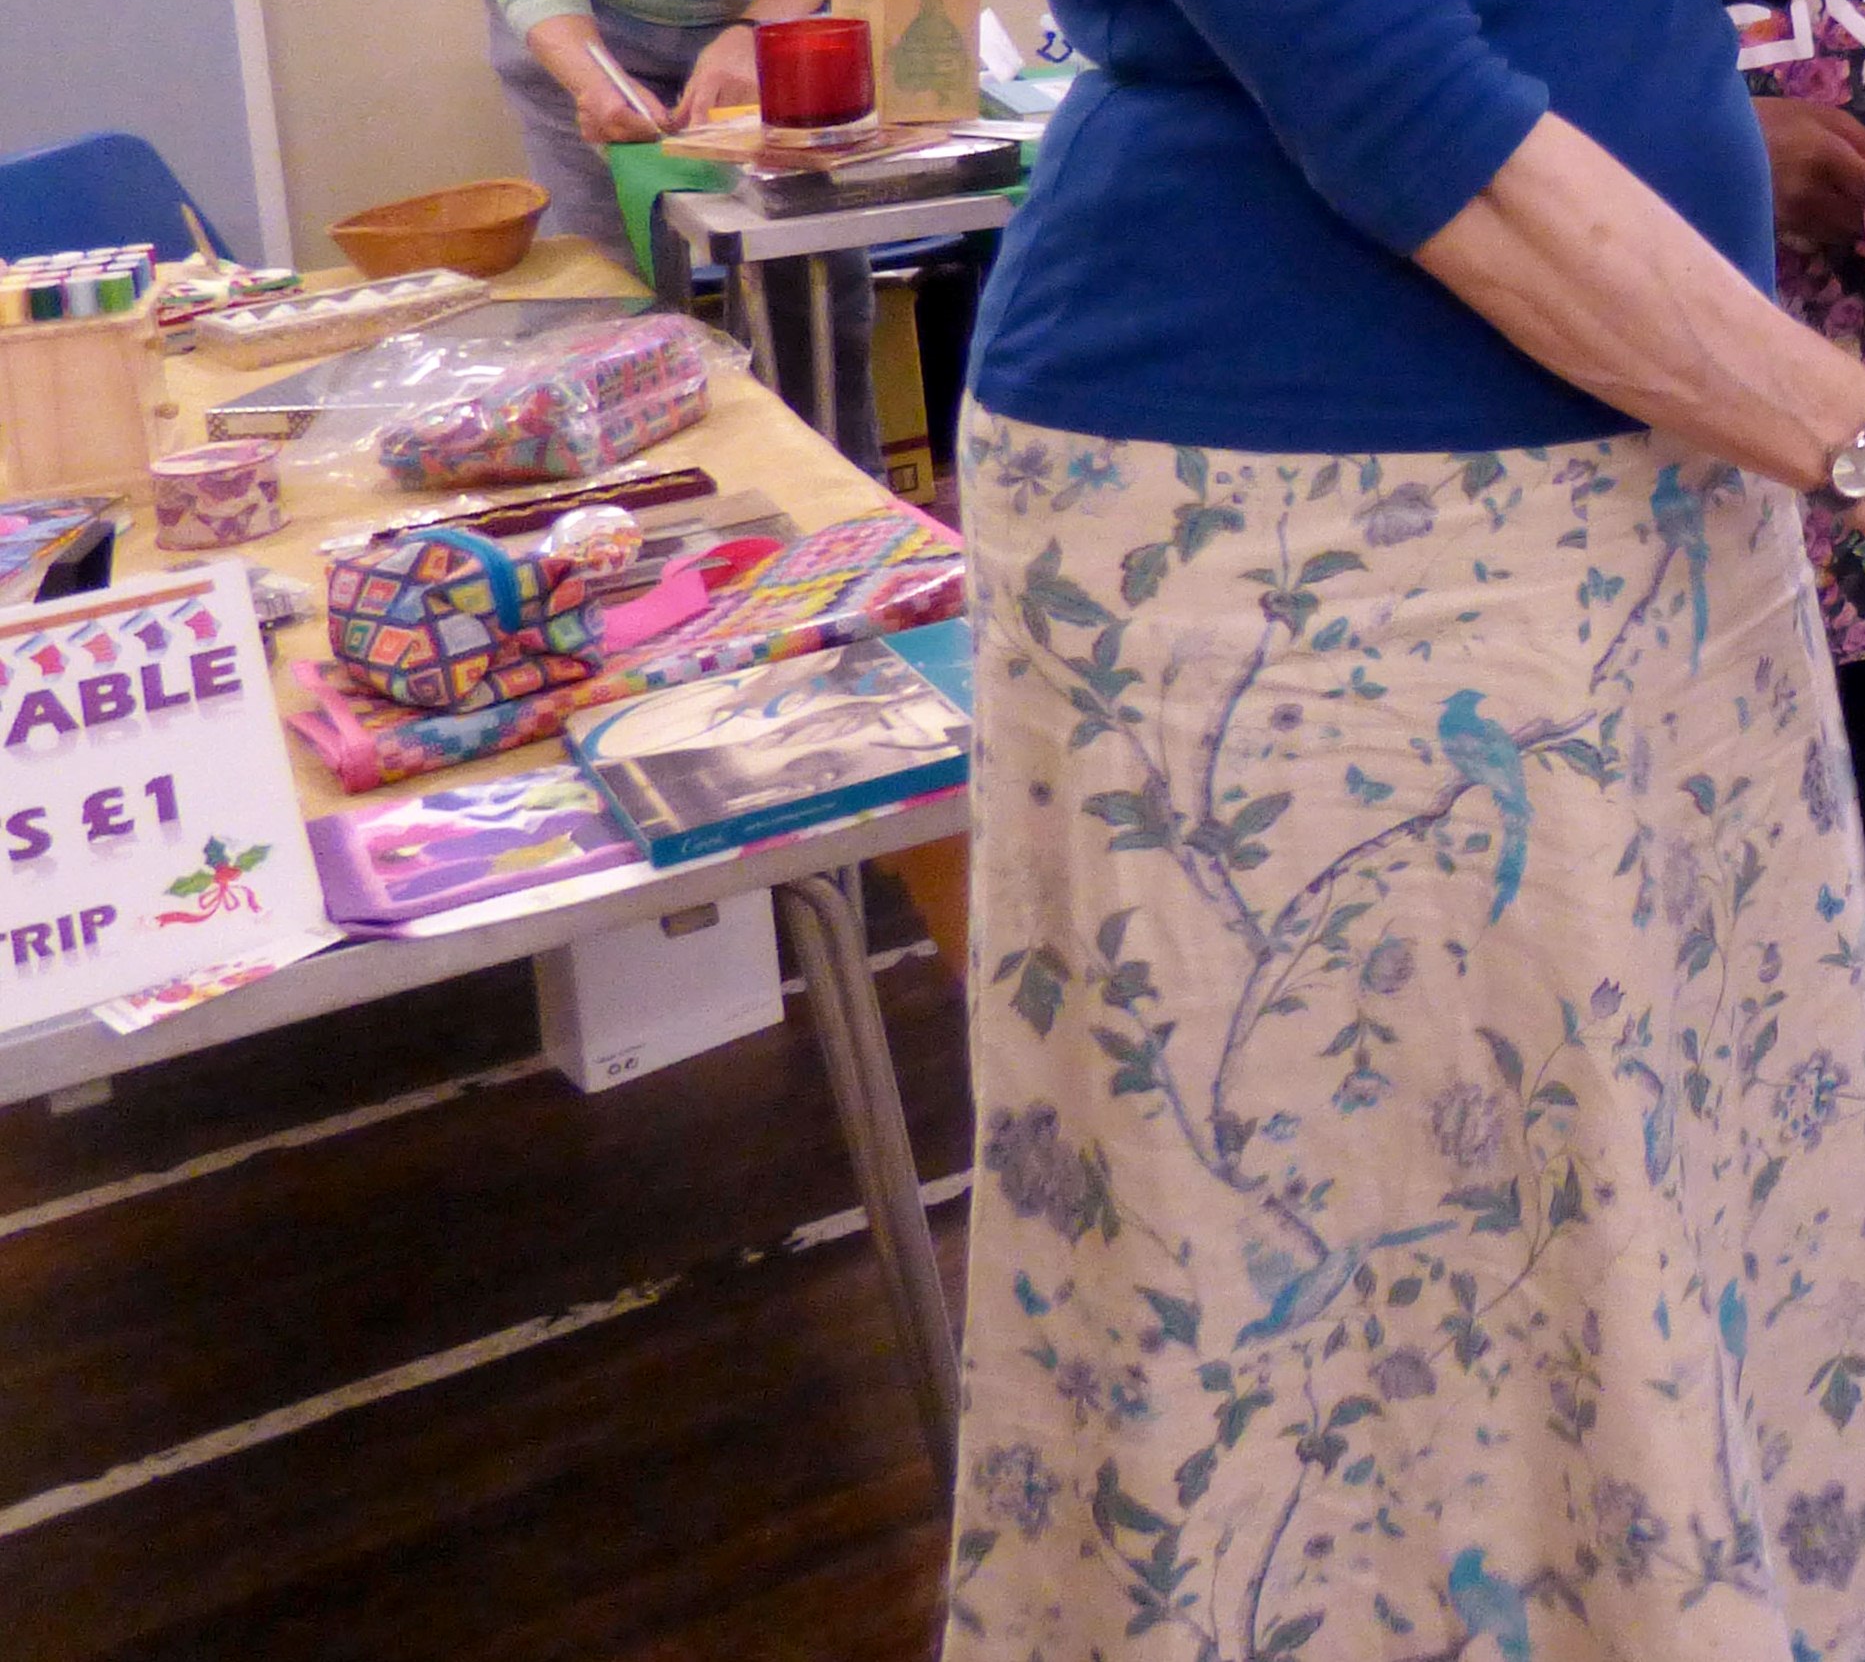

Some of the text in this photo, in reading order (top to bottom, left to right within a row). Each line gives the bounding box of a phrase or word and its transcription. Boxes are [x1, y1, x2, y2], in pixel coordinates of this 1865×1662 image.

[0, 645, 243, 747] ABLE
[2, 774, 179, 862] S £1
[0, 904, 118, 965] RIP
